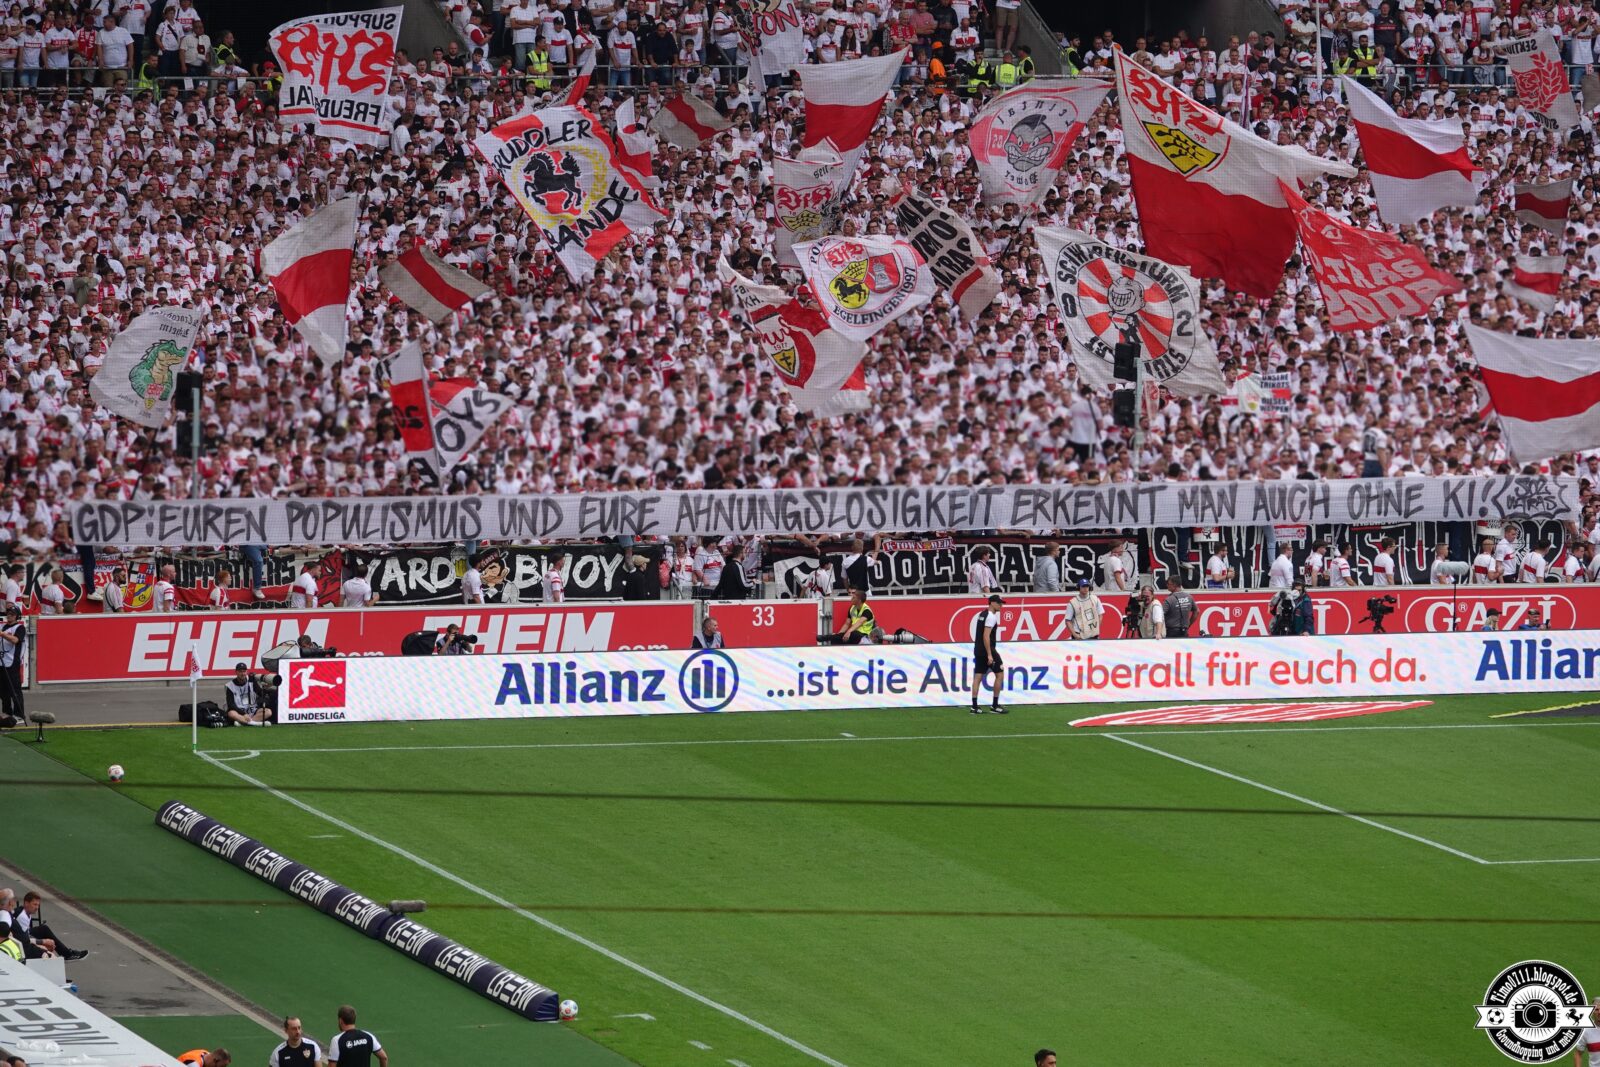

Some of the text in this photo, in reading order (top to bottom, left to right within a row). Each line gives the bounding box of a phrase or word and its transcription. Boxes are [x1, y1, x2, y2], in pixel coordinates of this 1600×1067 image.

[832, 290, 906, 325] EGELFINGEN
[286, 497, 482, 541] POPULISMUS
[499, 497, 564, 537] UND
[579, 495, 661, 536] EURE
[676, 487, 1004, 533] AHNUNGSLOSIGKEIT
[1011, 484, 1168, 526] ERKENNT
[1177, 484, 1238, 524] MAN
[1253, 479, 1330, 524] AUCH
[1347, 482, 1425, 520] OHNE
[752, 606, 775, 627] 33
[494, 661, 666, 706] Allianz
[851, 659, 908, 694] die
[1062, 652, 1196, 690] überall
[1206, 651, 1259, 687] für
[1269, 648, 1357, 685] euch
[1369, 647, 1427, 684] da.
[288, 711, 346, 721] BUNDESLIGA
